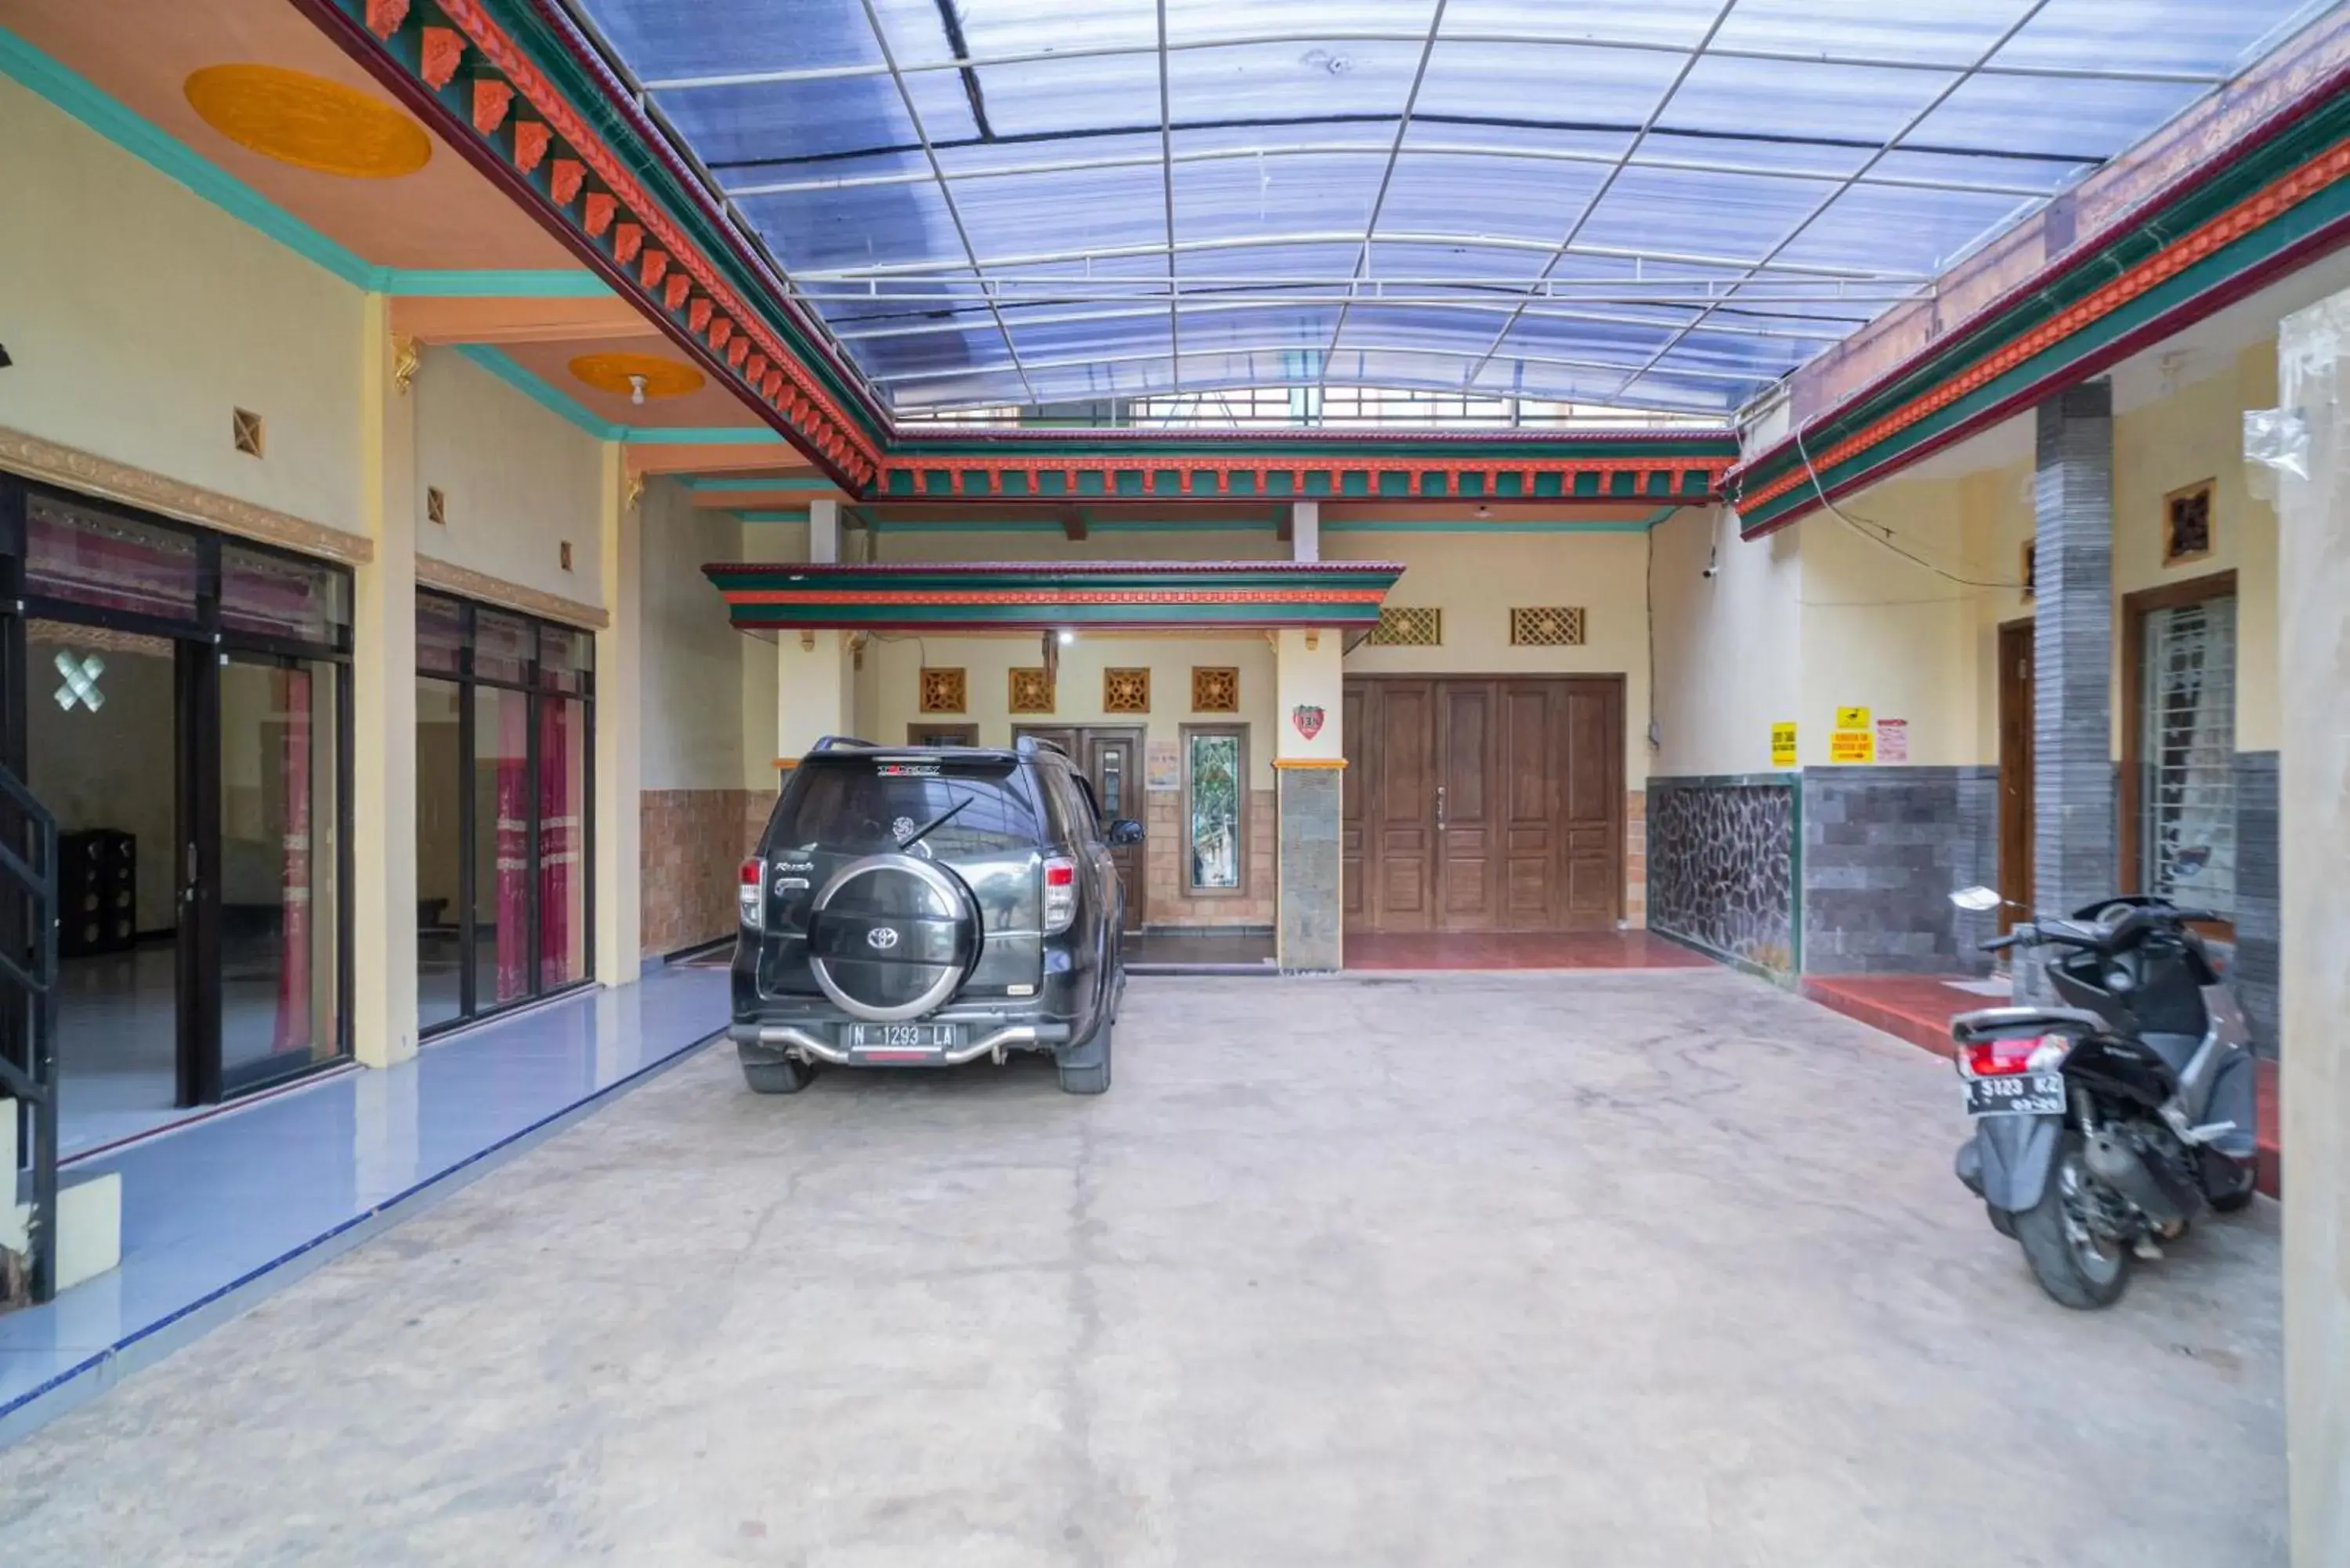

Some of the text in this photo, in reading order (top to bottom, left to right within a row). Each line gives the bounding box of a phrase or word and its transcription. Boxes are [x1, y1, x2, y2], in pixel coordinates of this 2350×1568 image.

[776, 862, 814, 871] Rush
[855, 1024, 952, 1046] N 1293 LA
